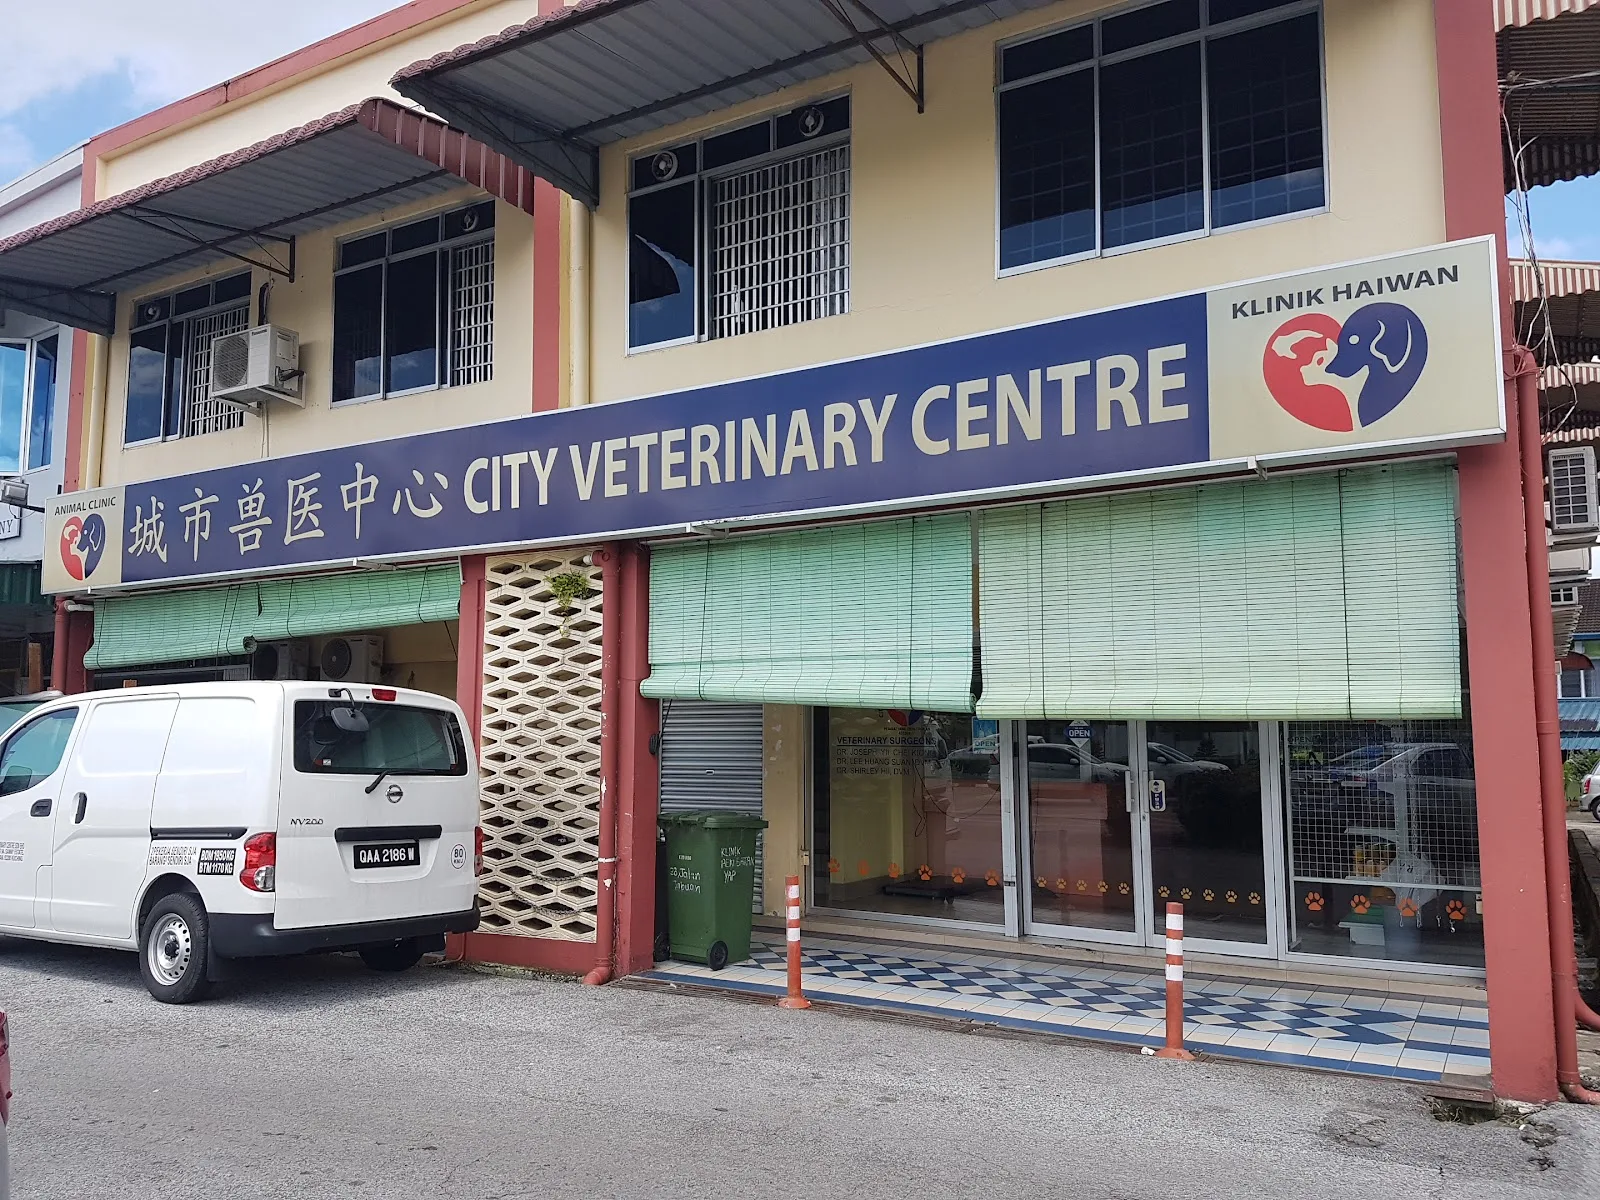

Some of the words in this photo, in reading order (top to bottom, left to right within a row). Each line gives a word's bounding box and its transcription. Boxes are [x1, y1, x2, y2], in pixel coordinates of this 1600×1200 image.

[1232, 288, 1324, 319] KLINIK
[1332, 265, 1458, 302] HAIWAN
[463, 447, 558, 514] CITY
[569, 394, 898, 501] VETERINARY
[911, 343, 1189, 456] CENTRE
[54, 502, 87, 516] ANIMAL
[88, 497, 117, 510] CLINIC
[127, 461, 449, 564] 城市兽医中心
[1068, 729, 1091, 737] OPEN
[837, 736, 887, 745] VETERINARY
[889, 737, 937, 745] SURGEONS
[850, 767, 880, 775] SHIRLEY
[359, 849, 380, 863] QAA
[382, 848, 406, 862] 2186
[408, 848, 415, 860] W
[454, 848, 464, 858] 80
[198, 862, 212, 873] BTM
[212, 862, 225, 874] 1170
